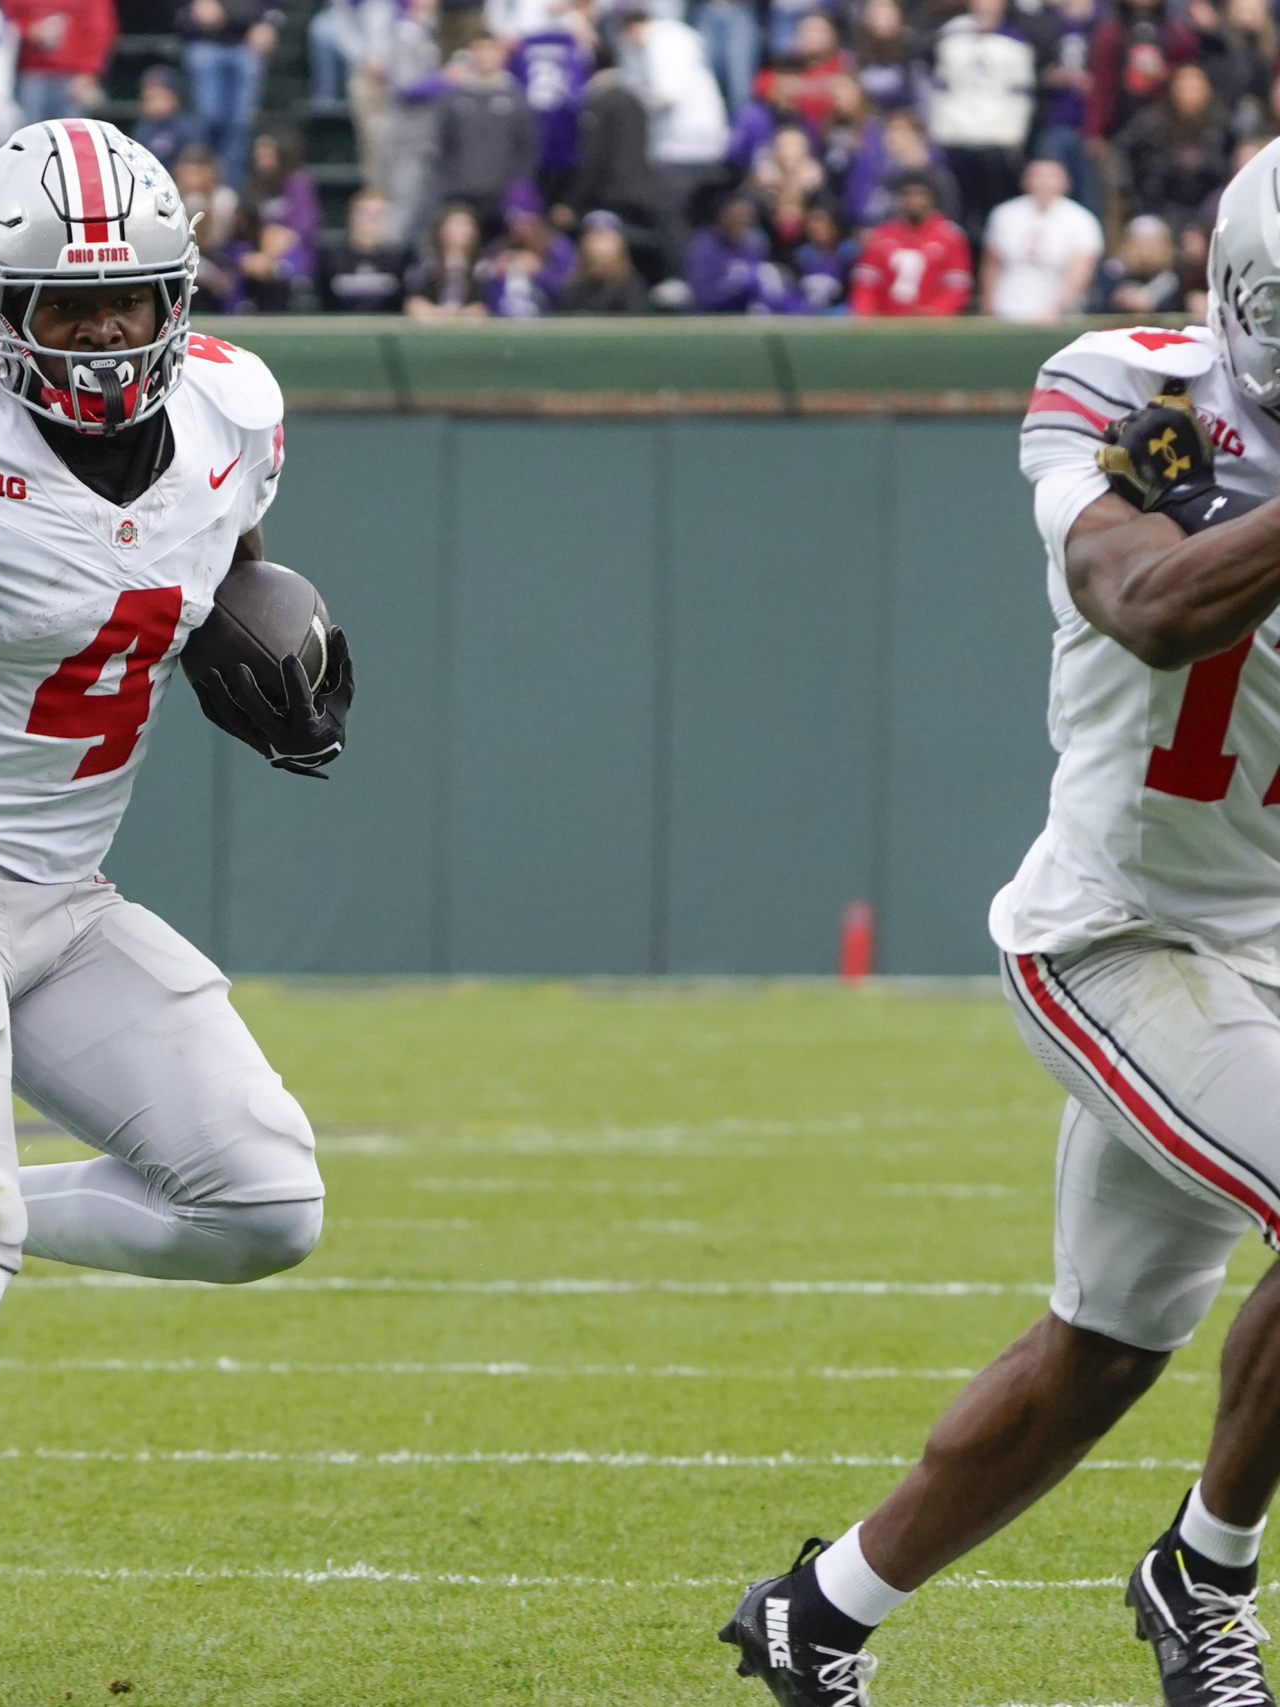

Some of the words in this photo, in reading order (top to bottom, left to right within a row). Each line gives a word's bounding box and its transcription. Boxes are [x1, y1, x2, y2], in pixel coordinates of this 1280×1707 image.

[67, 248, 94, 263] OHIO
[98, 247, 129, 262] STATE
[26, 585, 182, 780] 4
[1144, 630, 1280, 807] 1
[766, 1598, 793, 1668] NIKE
